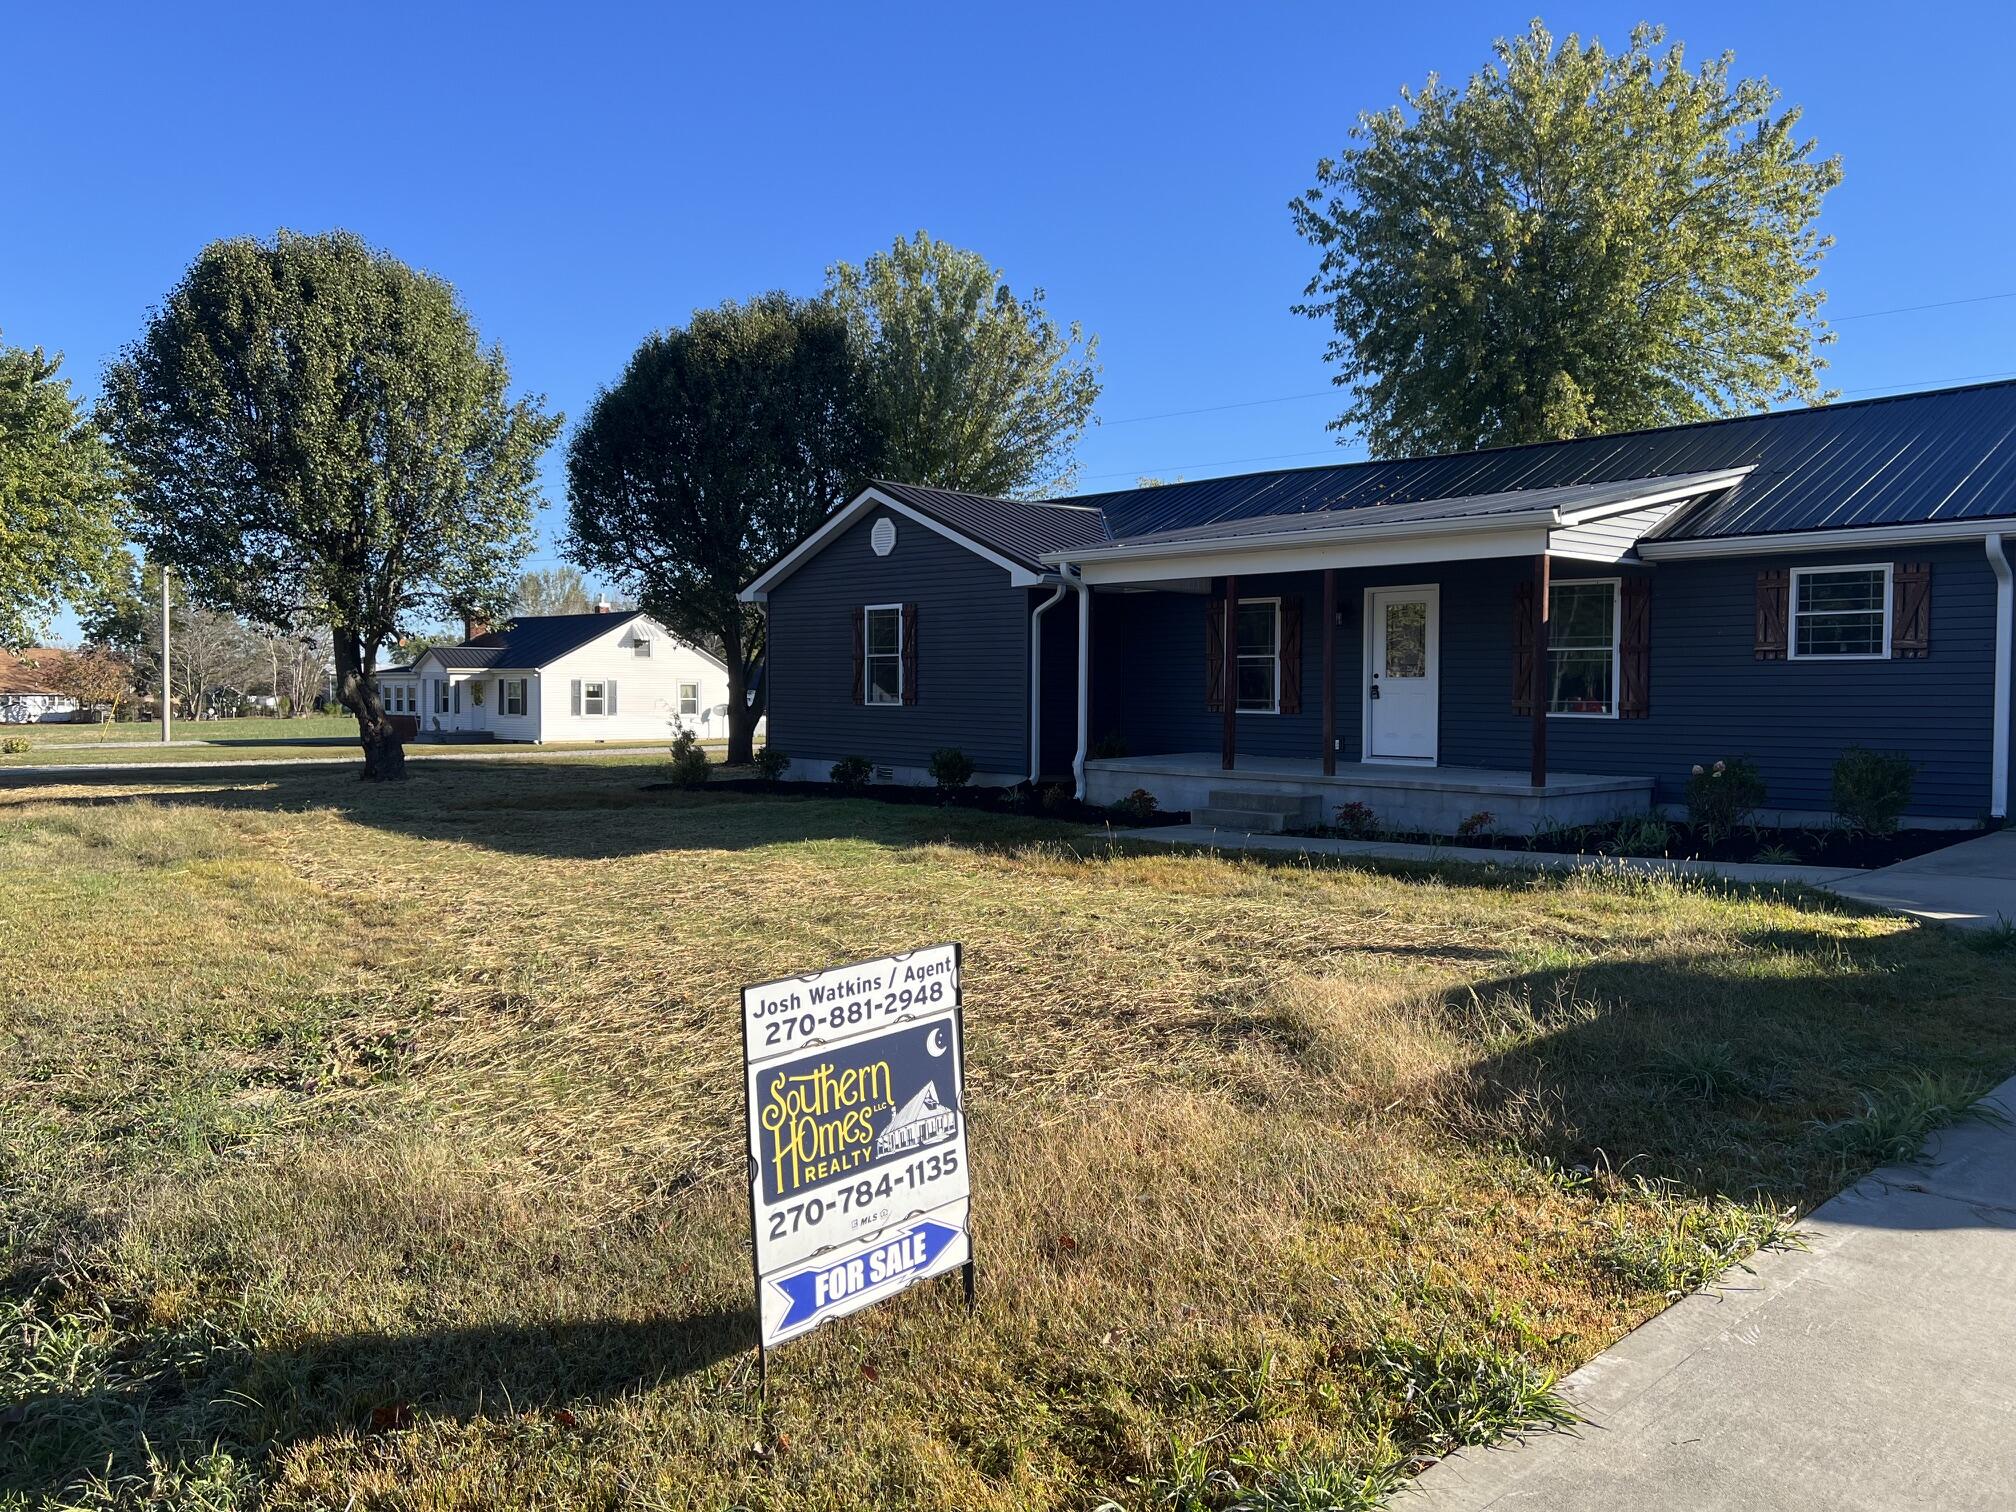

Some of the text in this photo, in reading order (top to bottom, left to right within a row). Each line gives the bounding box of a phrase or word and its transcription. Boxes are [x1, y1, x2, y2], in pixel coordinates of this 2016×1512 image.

[753, 956, 952, 1019] Josh Watkins / Agent
[765, 981, 944, 1046] 270-881-2948
[762, 1060, 895, 1131] Southern
[873, 1102, 888, 1113] LLC
[769, 1149, 959, 1242] 270-784-1135
[804, 1146, 872, 1183] REALTY
[860, 1213, 878, 1227] MLS
[815, 1231, 927, 1308] FOR SALE
